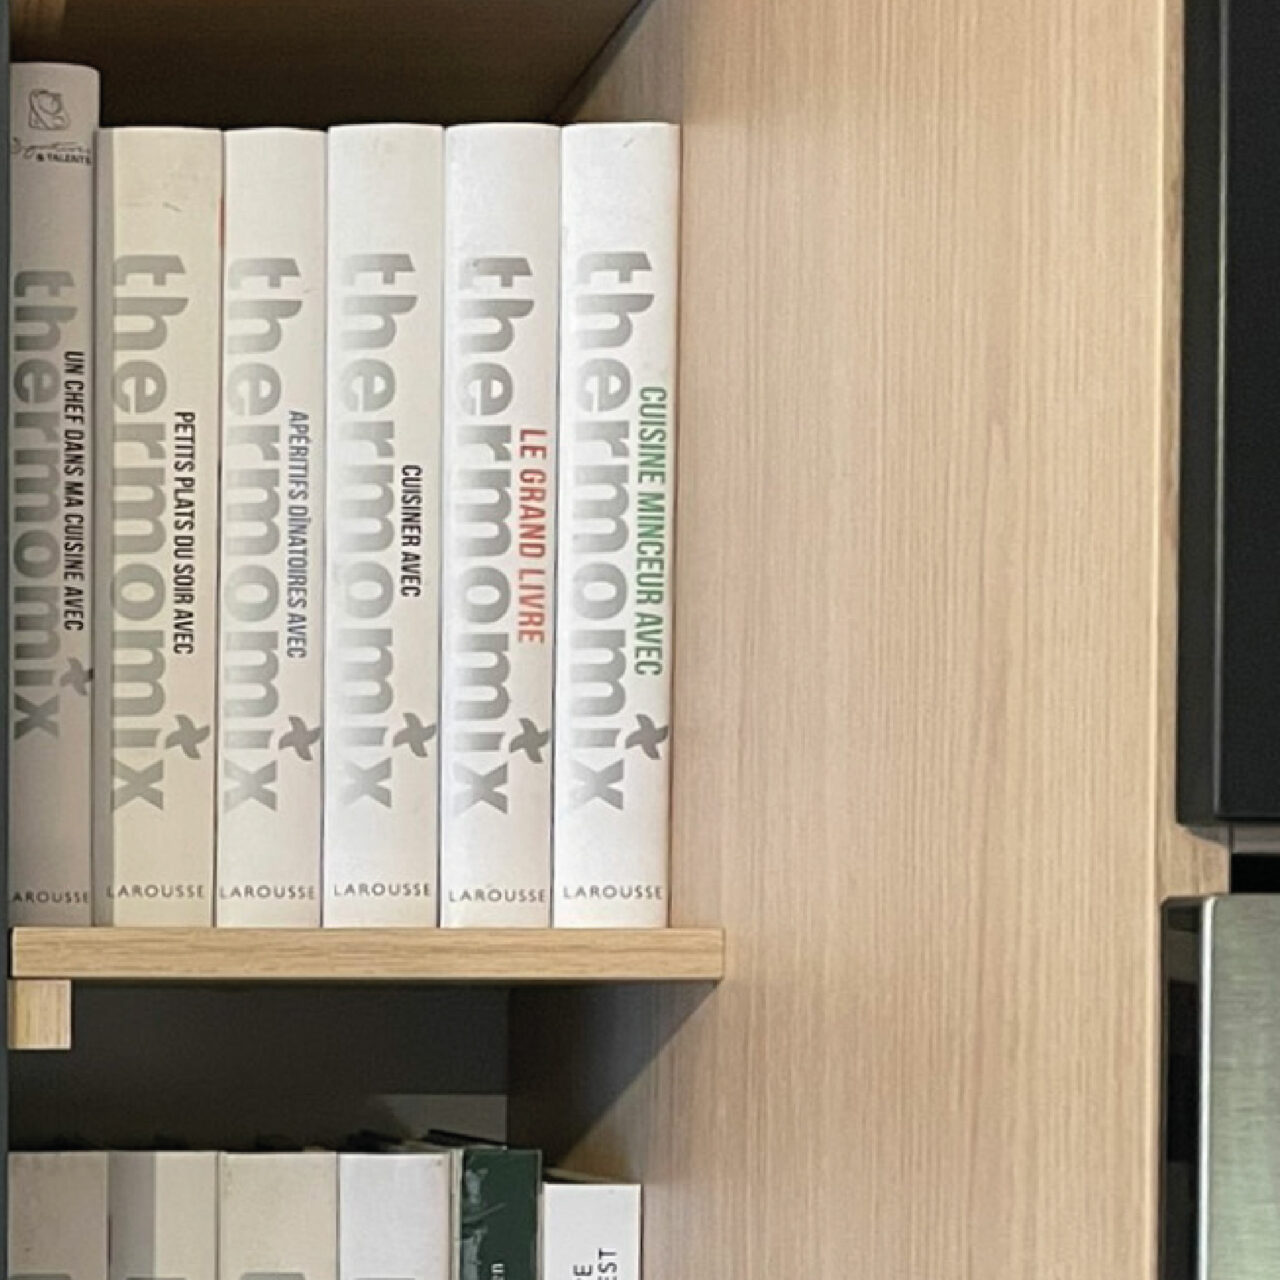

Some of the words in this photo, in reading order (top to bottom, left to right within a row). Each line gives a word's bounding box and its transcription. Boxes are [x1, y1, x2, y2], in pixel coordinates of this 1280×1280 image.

[64, 351, 84, 374] UN
[64, 380, 84, 425] CHEF
[64, 429, 84, 477] DANS
[174, 411, 195, 474] PETITS
[288, 410, 312, 500] APÉRITIFS
[520, 429, 547, 459] LE
[637, 386, 666, 484] CUISINE
[13, 270, 93, 740] thermomix
[64, 481, 84, 508] MA
[174, 477, 195, 532] PLATS
[401, 464, 423, 547] CUISINER
[519, 468, 547, 558] GRAND
[64, 514, 84, 581] CUISINE
[110, 255, 210, 811] thermomix
[174, 535, 195, 560] DU
[223, 258, 320, 813] thermomix
[287, 505, 311, 608] DÎNATOIRES
[332, 253, 437, 810] thermomix
[452, 257, 551, 815] thermomix
[570, 251, 669, 811] thermomix
[637, 491, 666, 605] MINCEUR
[174, 564, 195, 604] SOIR
[401, 551, 421, 598] AVEC
[64, 586, 84, 631] AVEC
[518, 568, 545, 643] LIVRE
[174, 608, 195, 655] AVEC
[287, 612, 307, 659] AVEC
[634, 611, 663, 676] AVEC
[10, 891, 89, 904] AROUSSE
[106, 884, 204, 898] LAROUSSE
[220, 885, 315, 899] LAROUSSE
[333, 883, 431, 898] LAROUSSE
[448, 888, 546, 903] LAROUSSE
[563, 885, 663, 900] LAROUSSE
